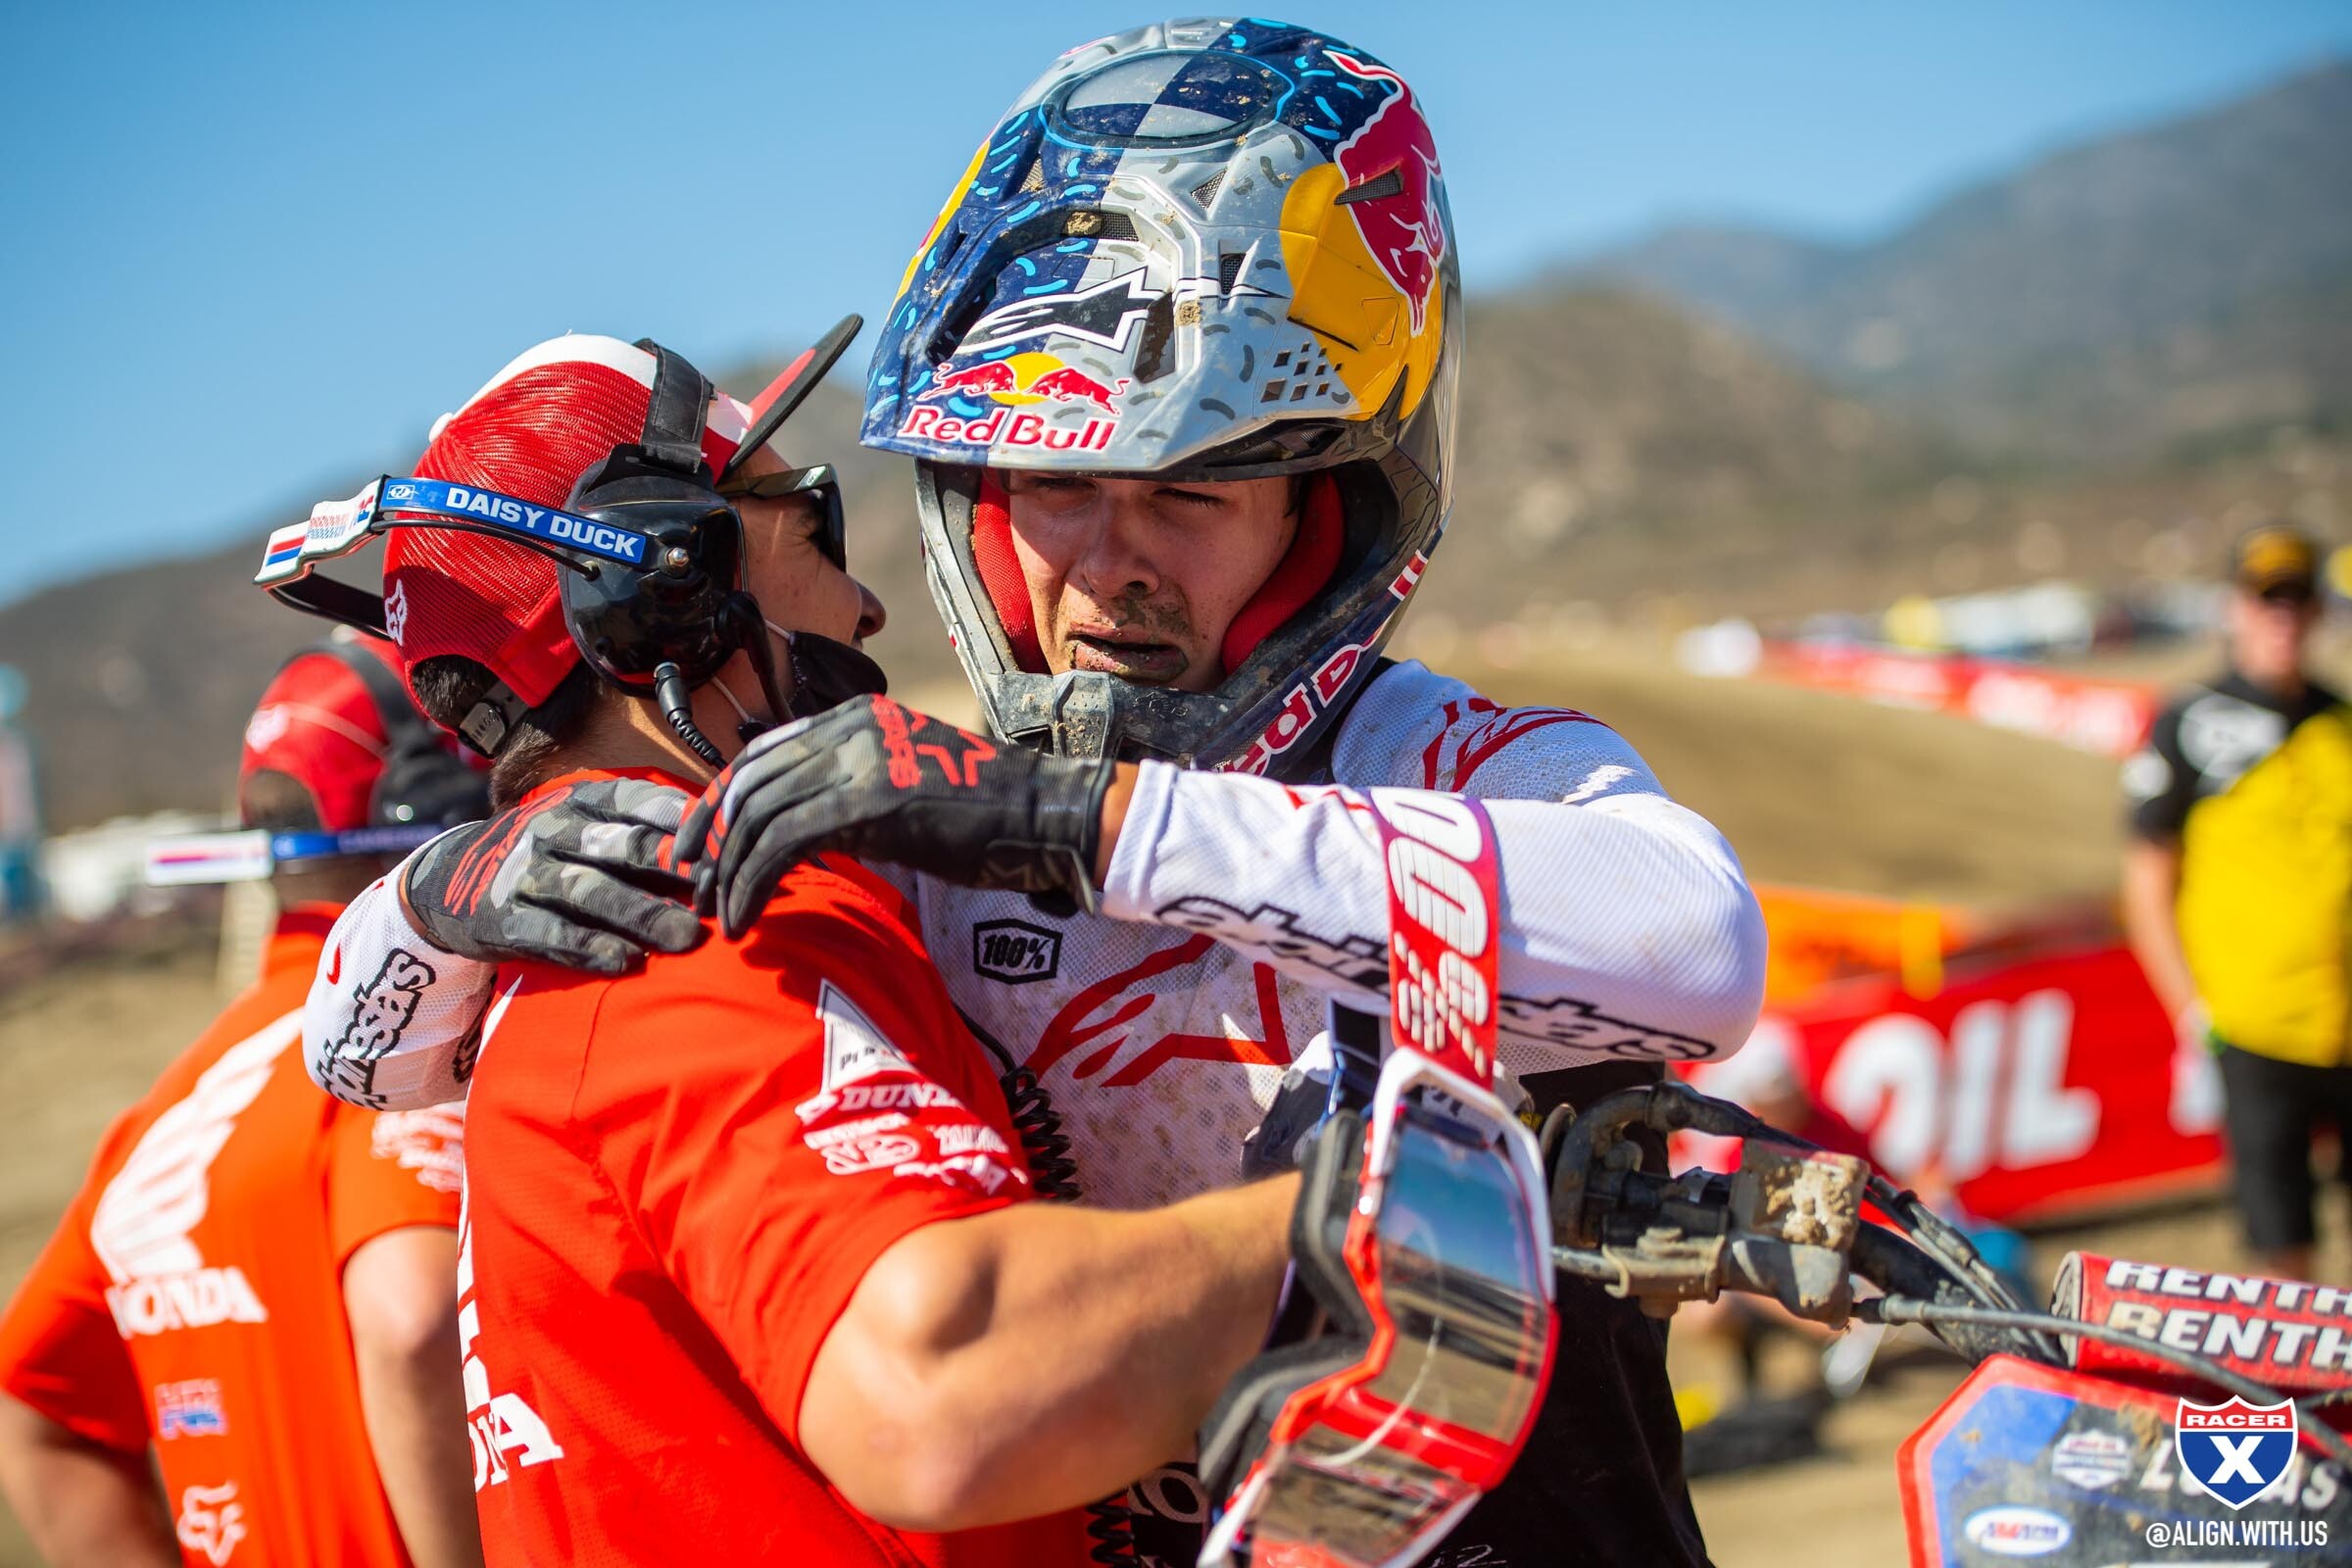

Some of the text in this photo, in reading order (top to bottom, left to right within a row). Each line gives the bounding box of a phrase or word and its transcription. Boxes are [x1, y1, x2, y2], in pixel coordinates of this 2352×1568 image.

[899, 406, 1118, 453] Red Bull
[446, 487, 639, 557] DAISY DUCK
[983, 934, 1051, 969] 100%
